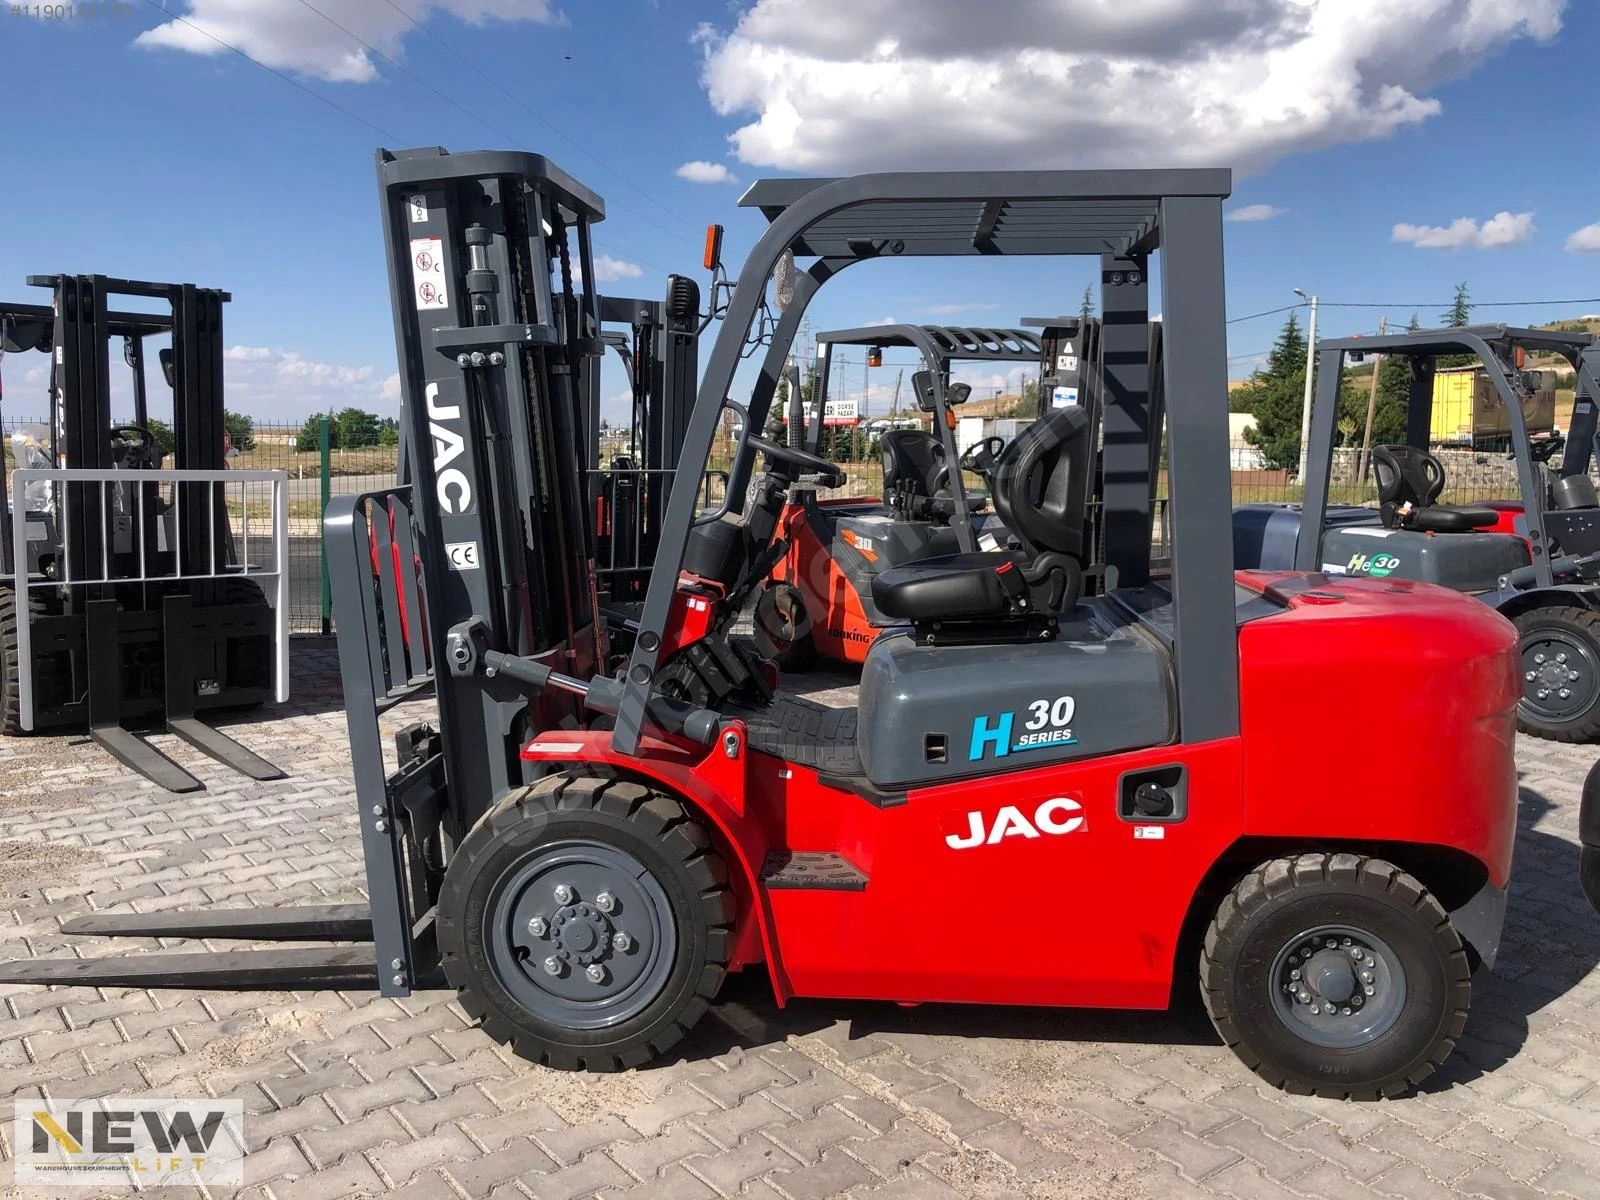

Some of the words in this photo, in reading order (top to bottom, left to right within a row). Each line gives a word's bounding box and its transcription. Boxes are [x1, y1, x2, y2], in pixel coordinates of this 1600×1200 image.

[425, 382, 471, 514] JAC
[451, 546, 475, 566] CE
[1375, 557, 1400, 569] 30
[969, 712, 1016, 760] H
[1025, 696, 1075, 730] 30
[1018, 728, 1072, 746] SERIES
[945, 797, 1084, 849] JAC
